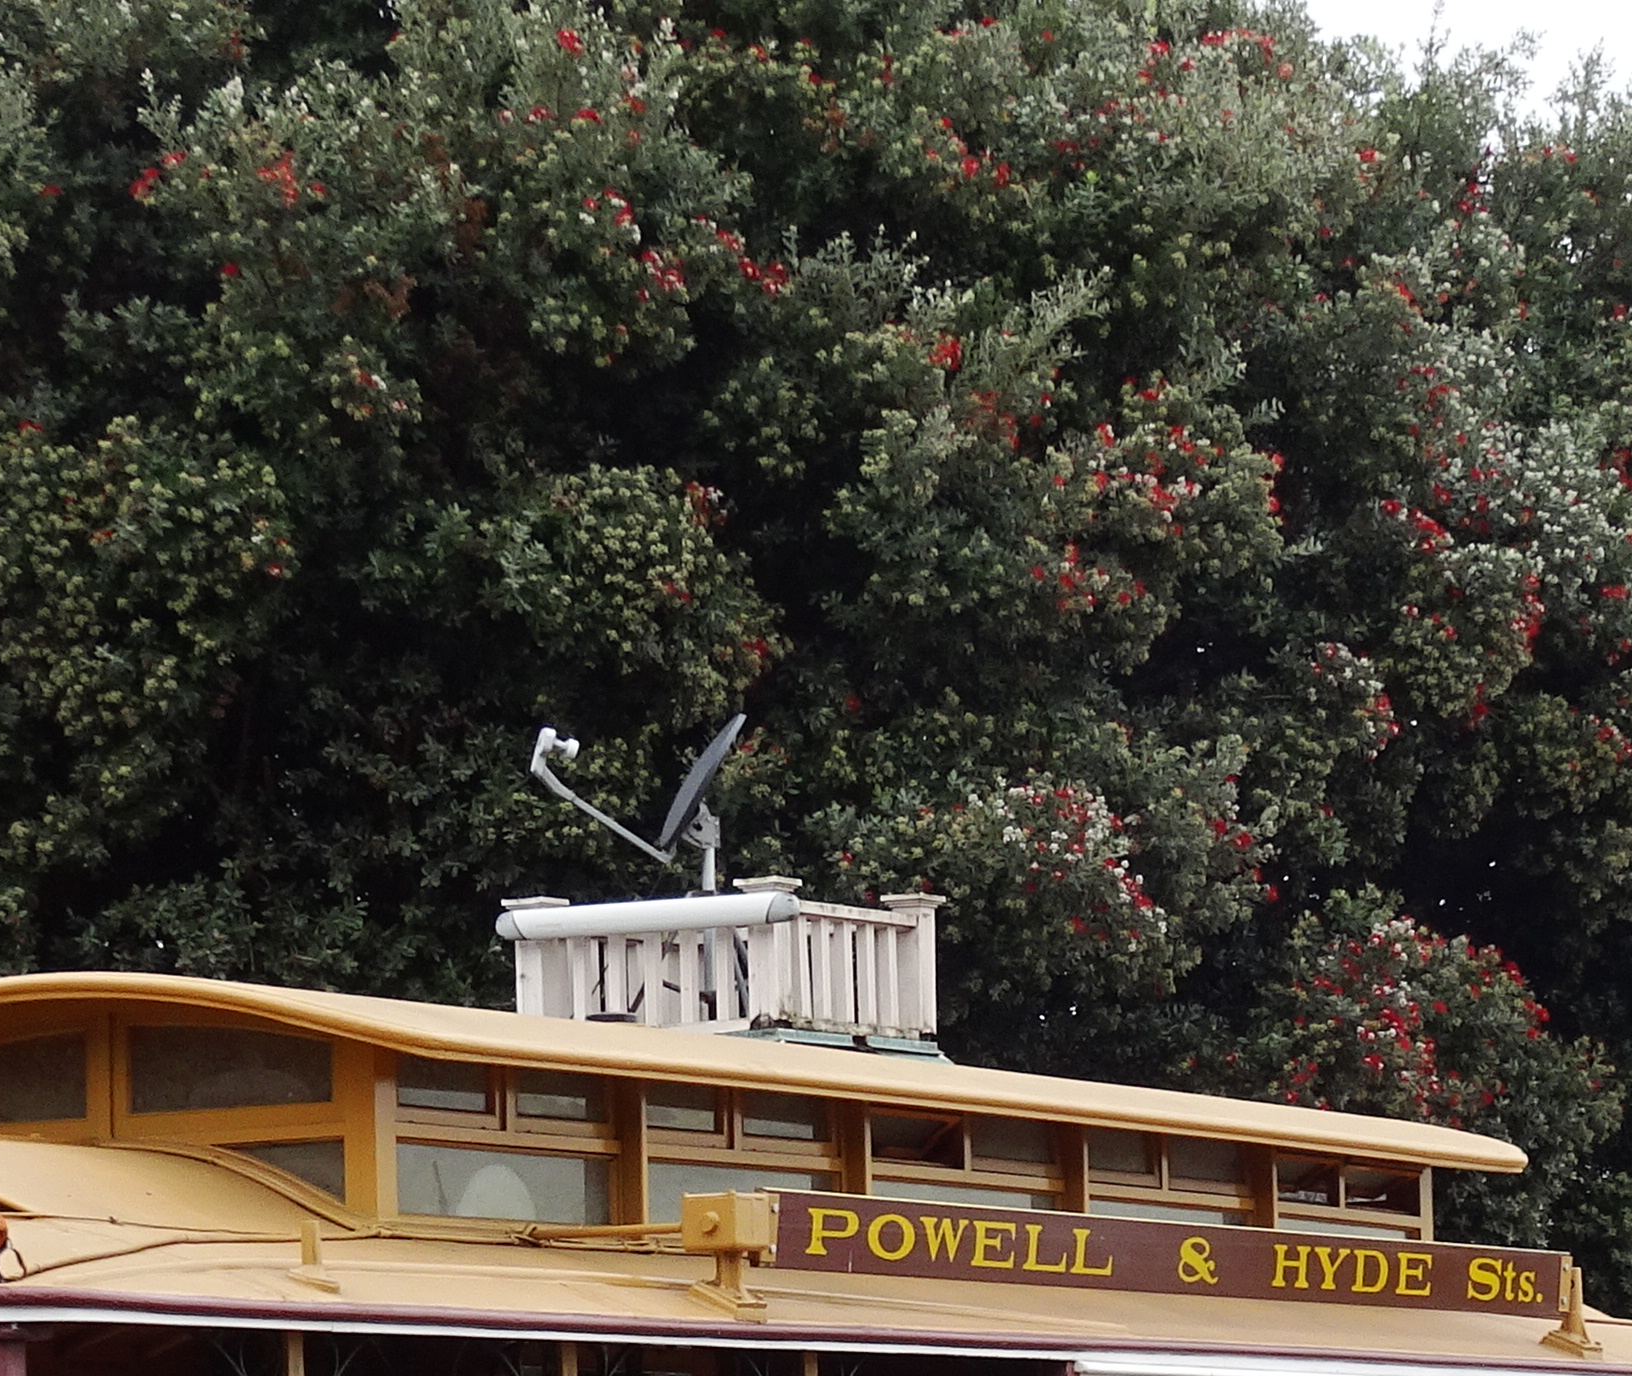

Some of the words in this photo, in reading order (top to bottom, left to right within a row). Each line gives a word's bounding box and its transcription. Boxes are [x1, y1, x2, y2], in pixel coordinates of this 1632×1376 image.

[805, 1207, 1114, 1278] POWELL
[1177, 1236, 1220, 1287] &
[1273, 1243, 1434, 1297] HYDE
